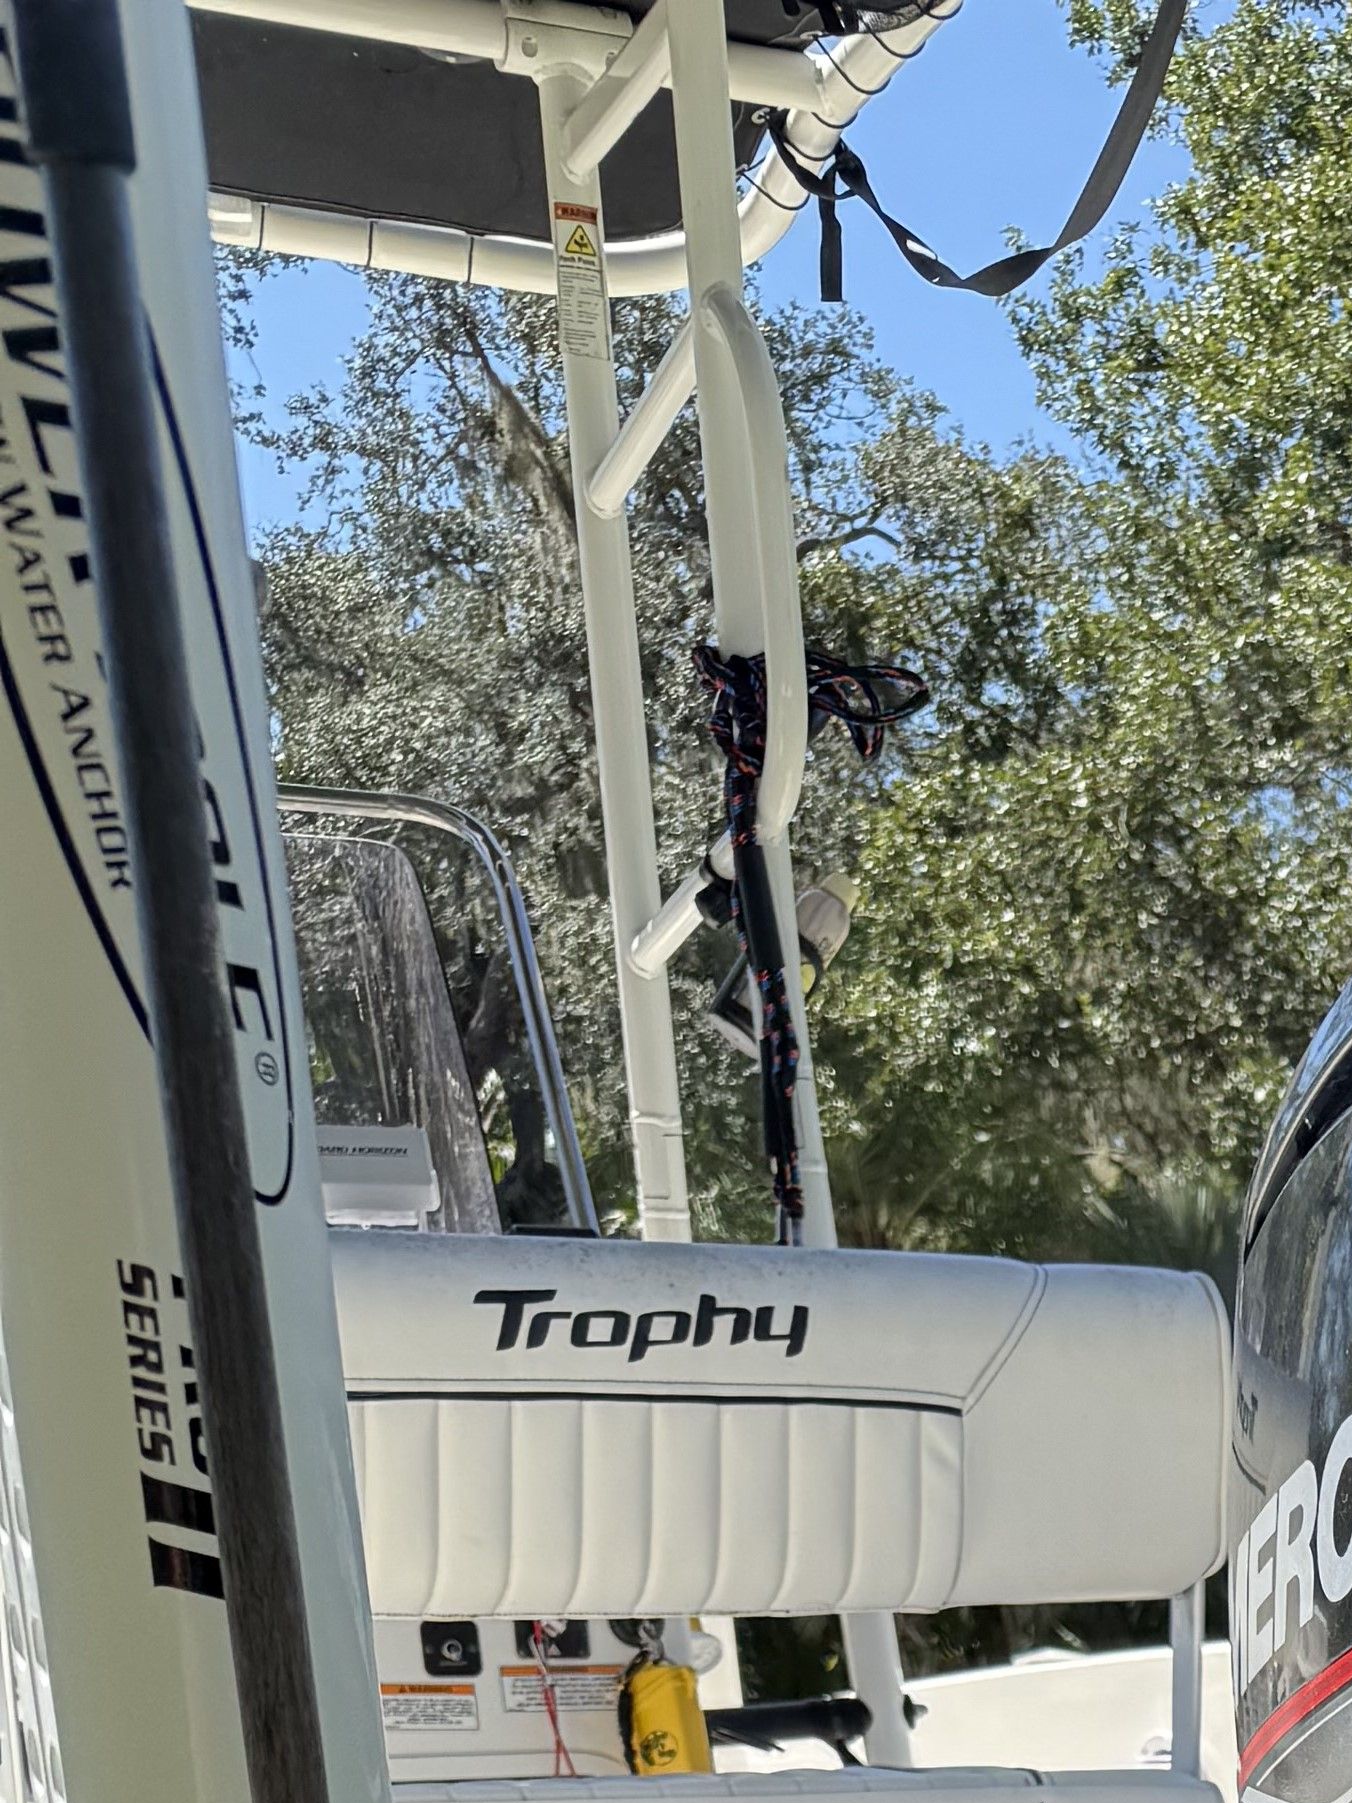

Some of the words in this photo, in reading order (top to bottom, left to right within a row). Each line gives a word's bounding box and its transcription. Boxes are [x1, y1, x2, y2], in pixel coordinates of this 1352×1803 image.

[0, 478, 73, 666] WATER
[116, 1258, 176, 1467] SERIES
[472, 1289, 809, 1363] Trophy
